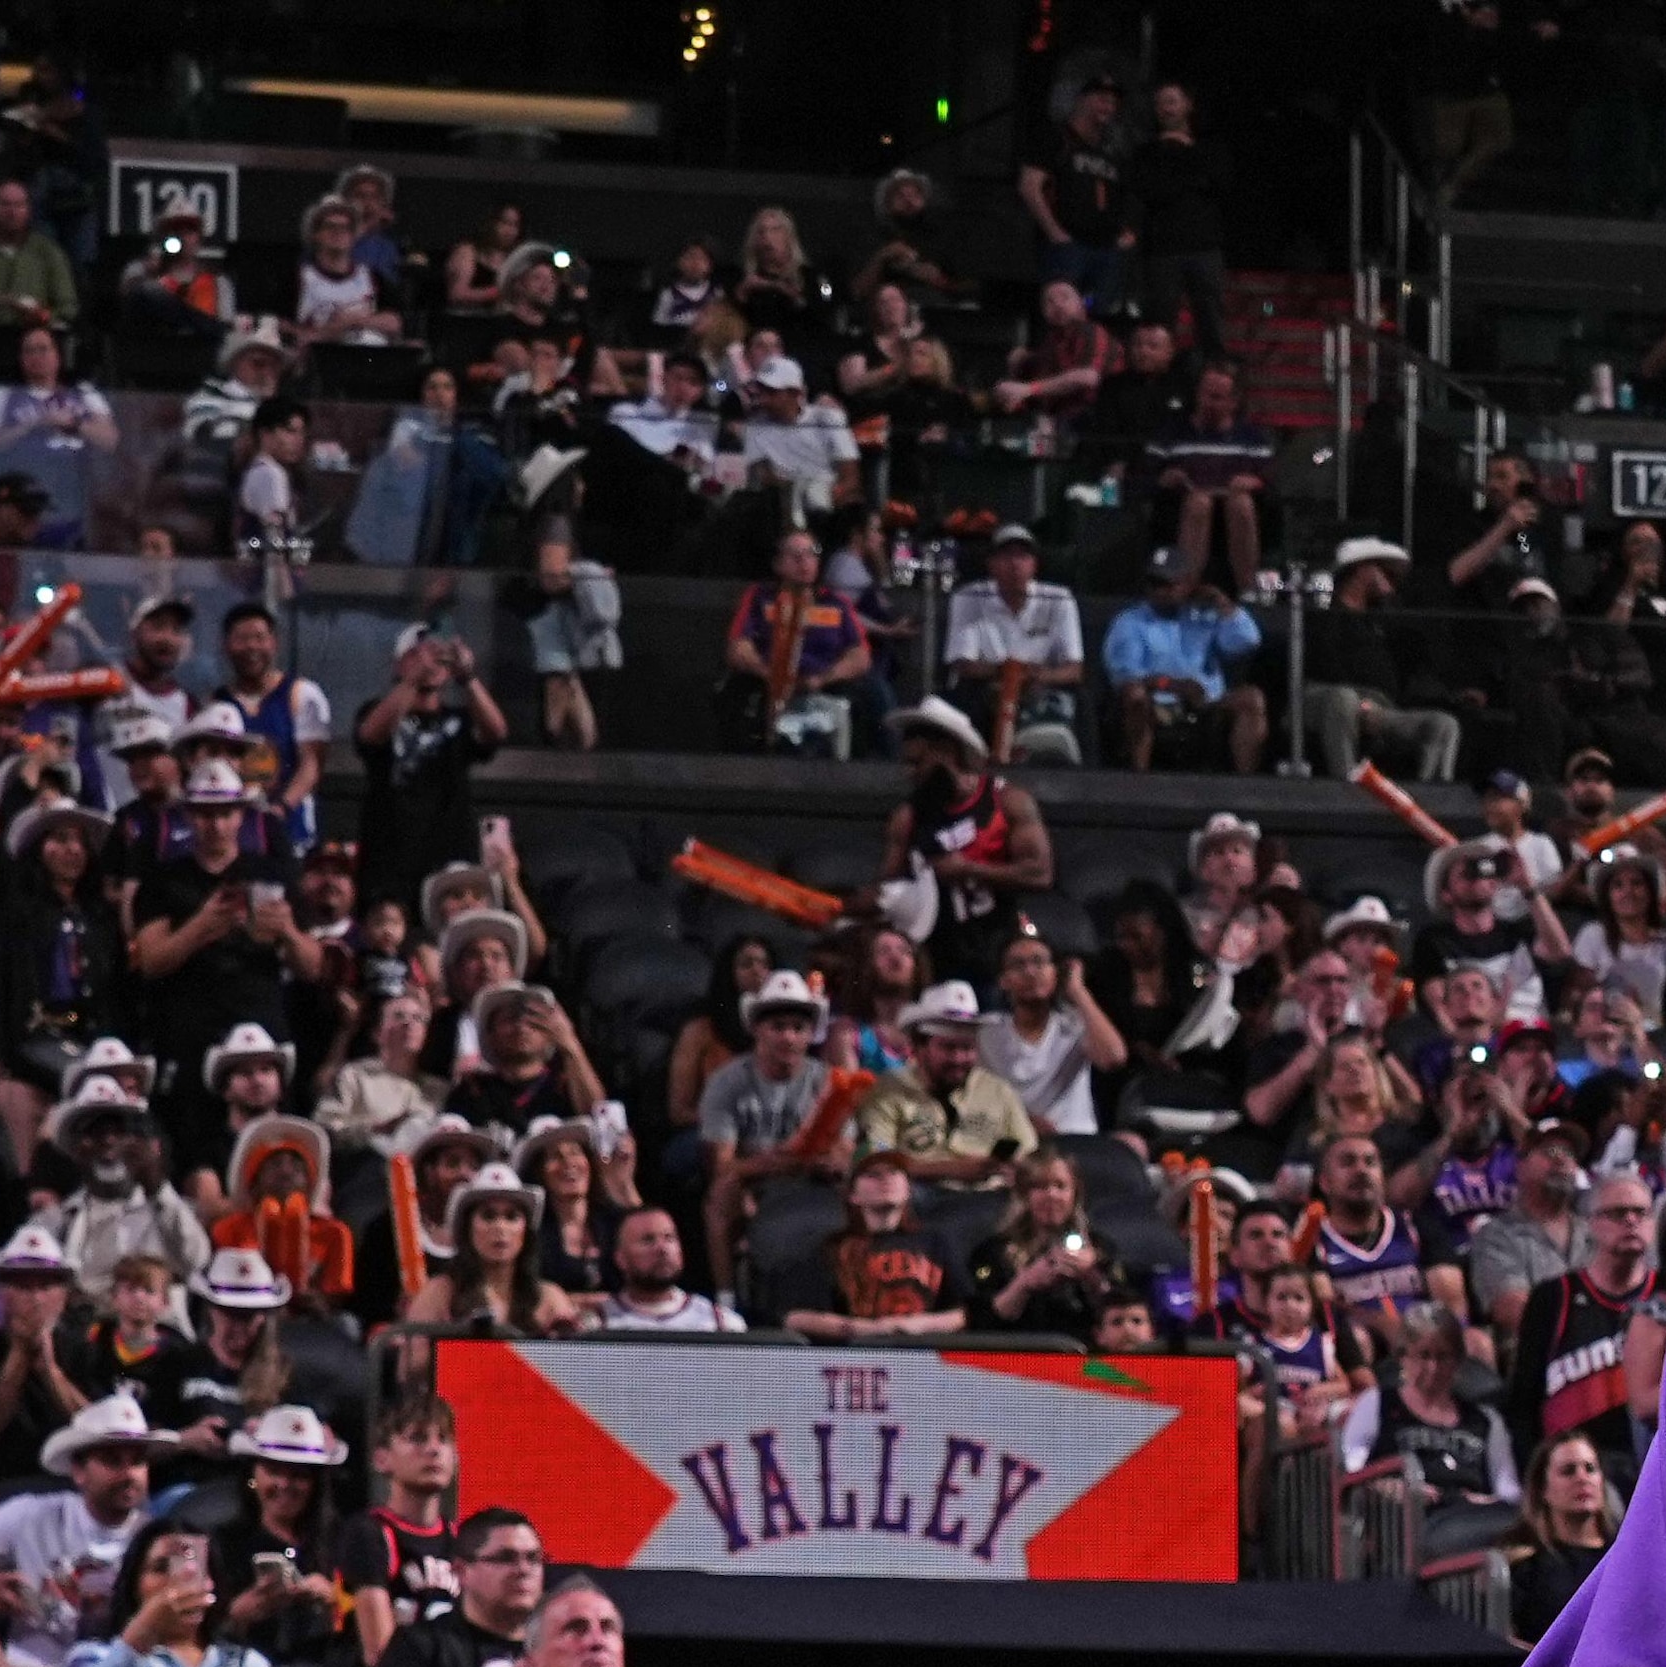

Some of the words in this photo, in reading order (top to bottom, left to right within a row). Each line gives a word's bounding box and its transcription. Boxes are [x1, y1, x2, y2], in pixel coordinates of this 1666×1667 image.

[134, 180, 219, 237] 120
[822, 1366, 890, 1413] THE
[1545, 1332, 1624, 1397] SUN
[681, 1422, 1044, 1561] VALLEY
